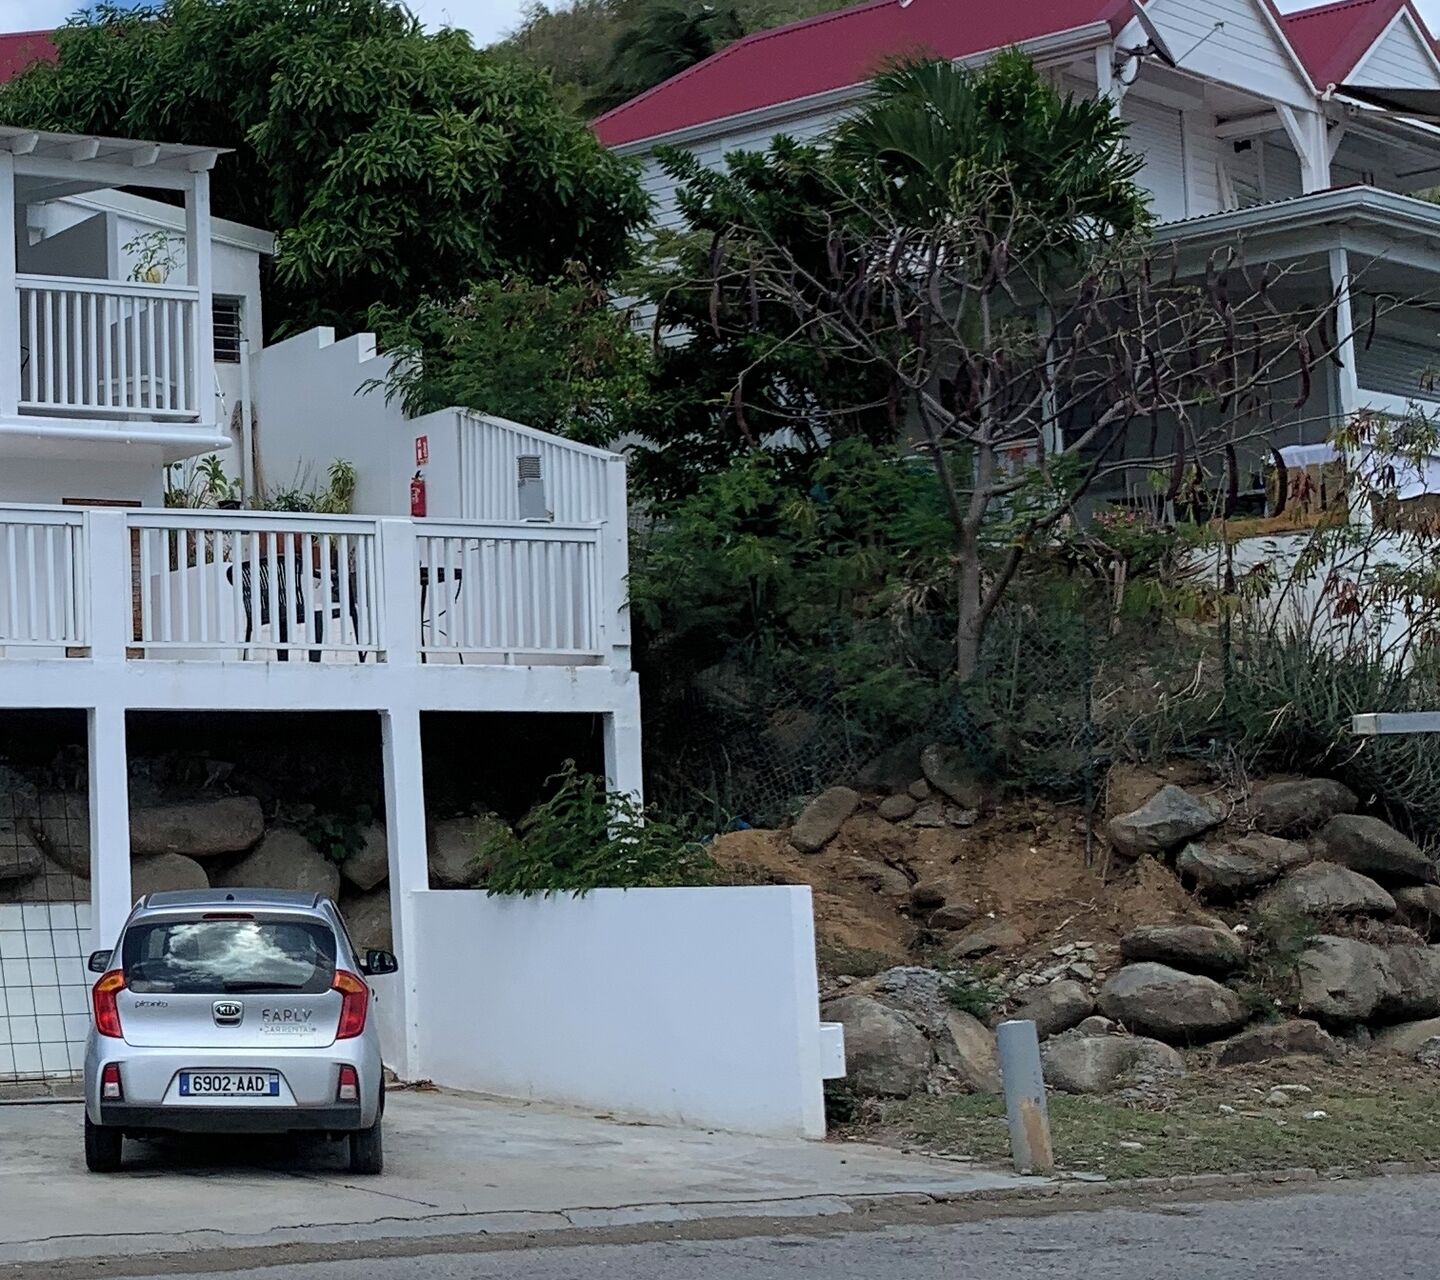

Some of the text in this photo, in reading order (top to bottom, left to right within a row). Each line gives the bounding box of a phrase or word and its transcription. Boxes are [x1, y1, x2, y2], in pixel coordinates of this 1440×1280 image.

[219, 1005, 237, 1015] KIA
[262, 1009, 312, 1023] EARLY
[193, 1076, 264, 1091] 6902-AAD
